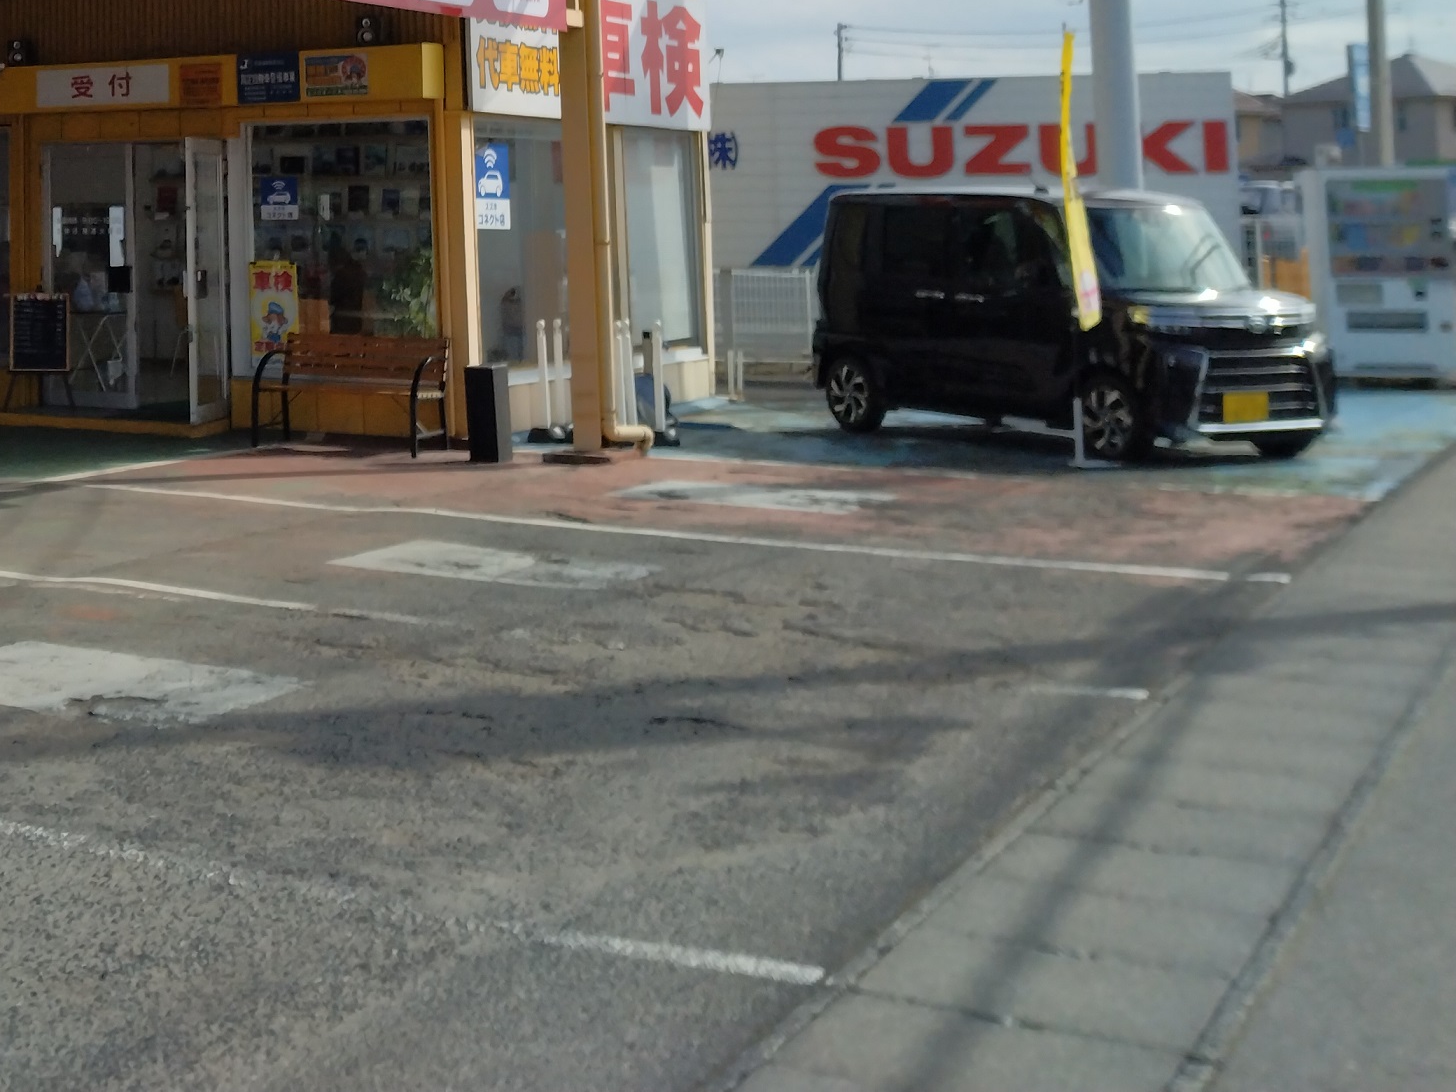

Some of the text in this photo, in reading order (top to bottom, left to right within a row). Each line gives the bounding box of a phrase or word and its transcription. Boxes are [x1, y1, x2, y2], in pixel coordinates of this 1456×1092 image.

[71, 71, 132, 99] 受付
[476, 35, 560, 97] 代車無料
[813, 119, 1231, 179] SUZUKI
[253, 270, 293, 293] 車検
